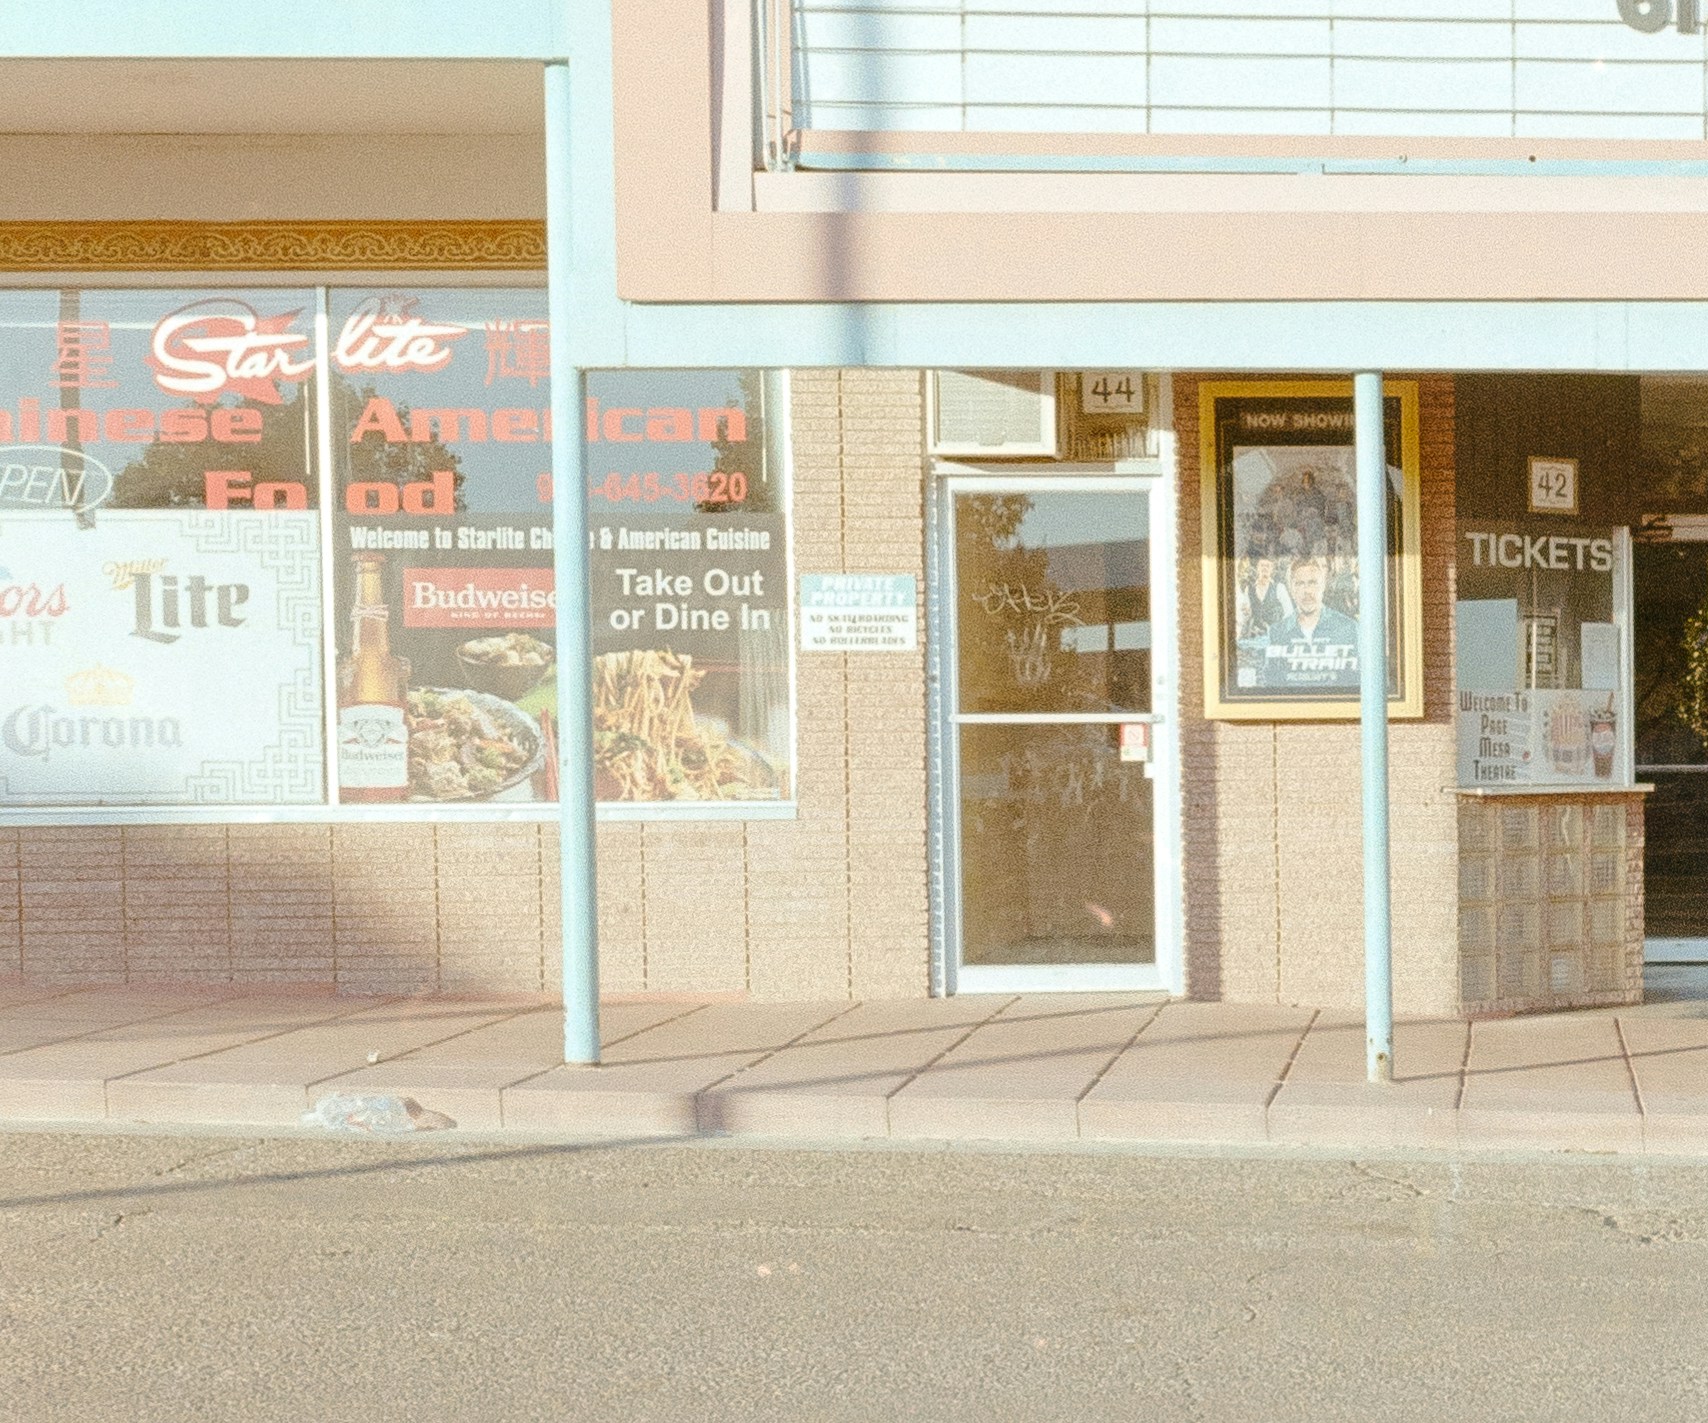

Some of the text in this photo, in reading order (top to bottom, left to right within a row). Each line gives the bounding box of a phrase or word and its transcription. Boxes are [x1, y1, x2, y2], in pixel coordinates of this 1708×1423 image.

[1091, 377, 1136, 404] 44
[351, 396, 748, 443] Ameican
[1244, 412, 1286, 429] NOW
[1537, 471, 1568, 499] 42
[350, 526, 429, 550] Welcome
[435, 527, 453, 550] to
[457, 527, 526, 550] Starlite
[599, 527, 614, 550] &
[618, 527, 701, 550] American
[706, 527, 771, 550] Cuisine
[1465, 532, 1613, 572] TICKETS
[615, 568, 765, 596] Take Out
[129, 572, 250, 644] Lite
[609, 603, 771, 630] or Dine In
[1265, 646, 1355, 658] BULLET
[1286, 657, 1358, 672] TRAIN
[3, 705, 183, 763] Corona
